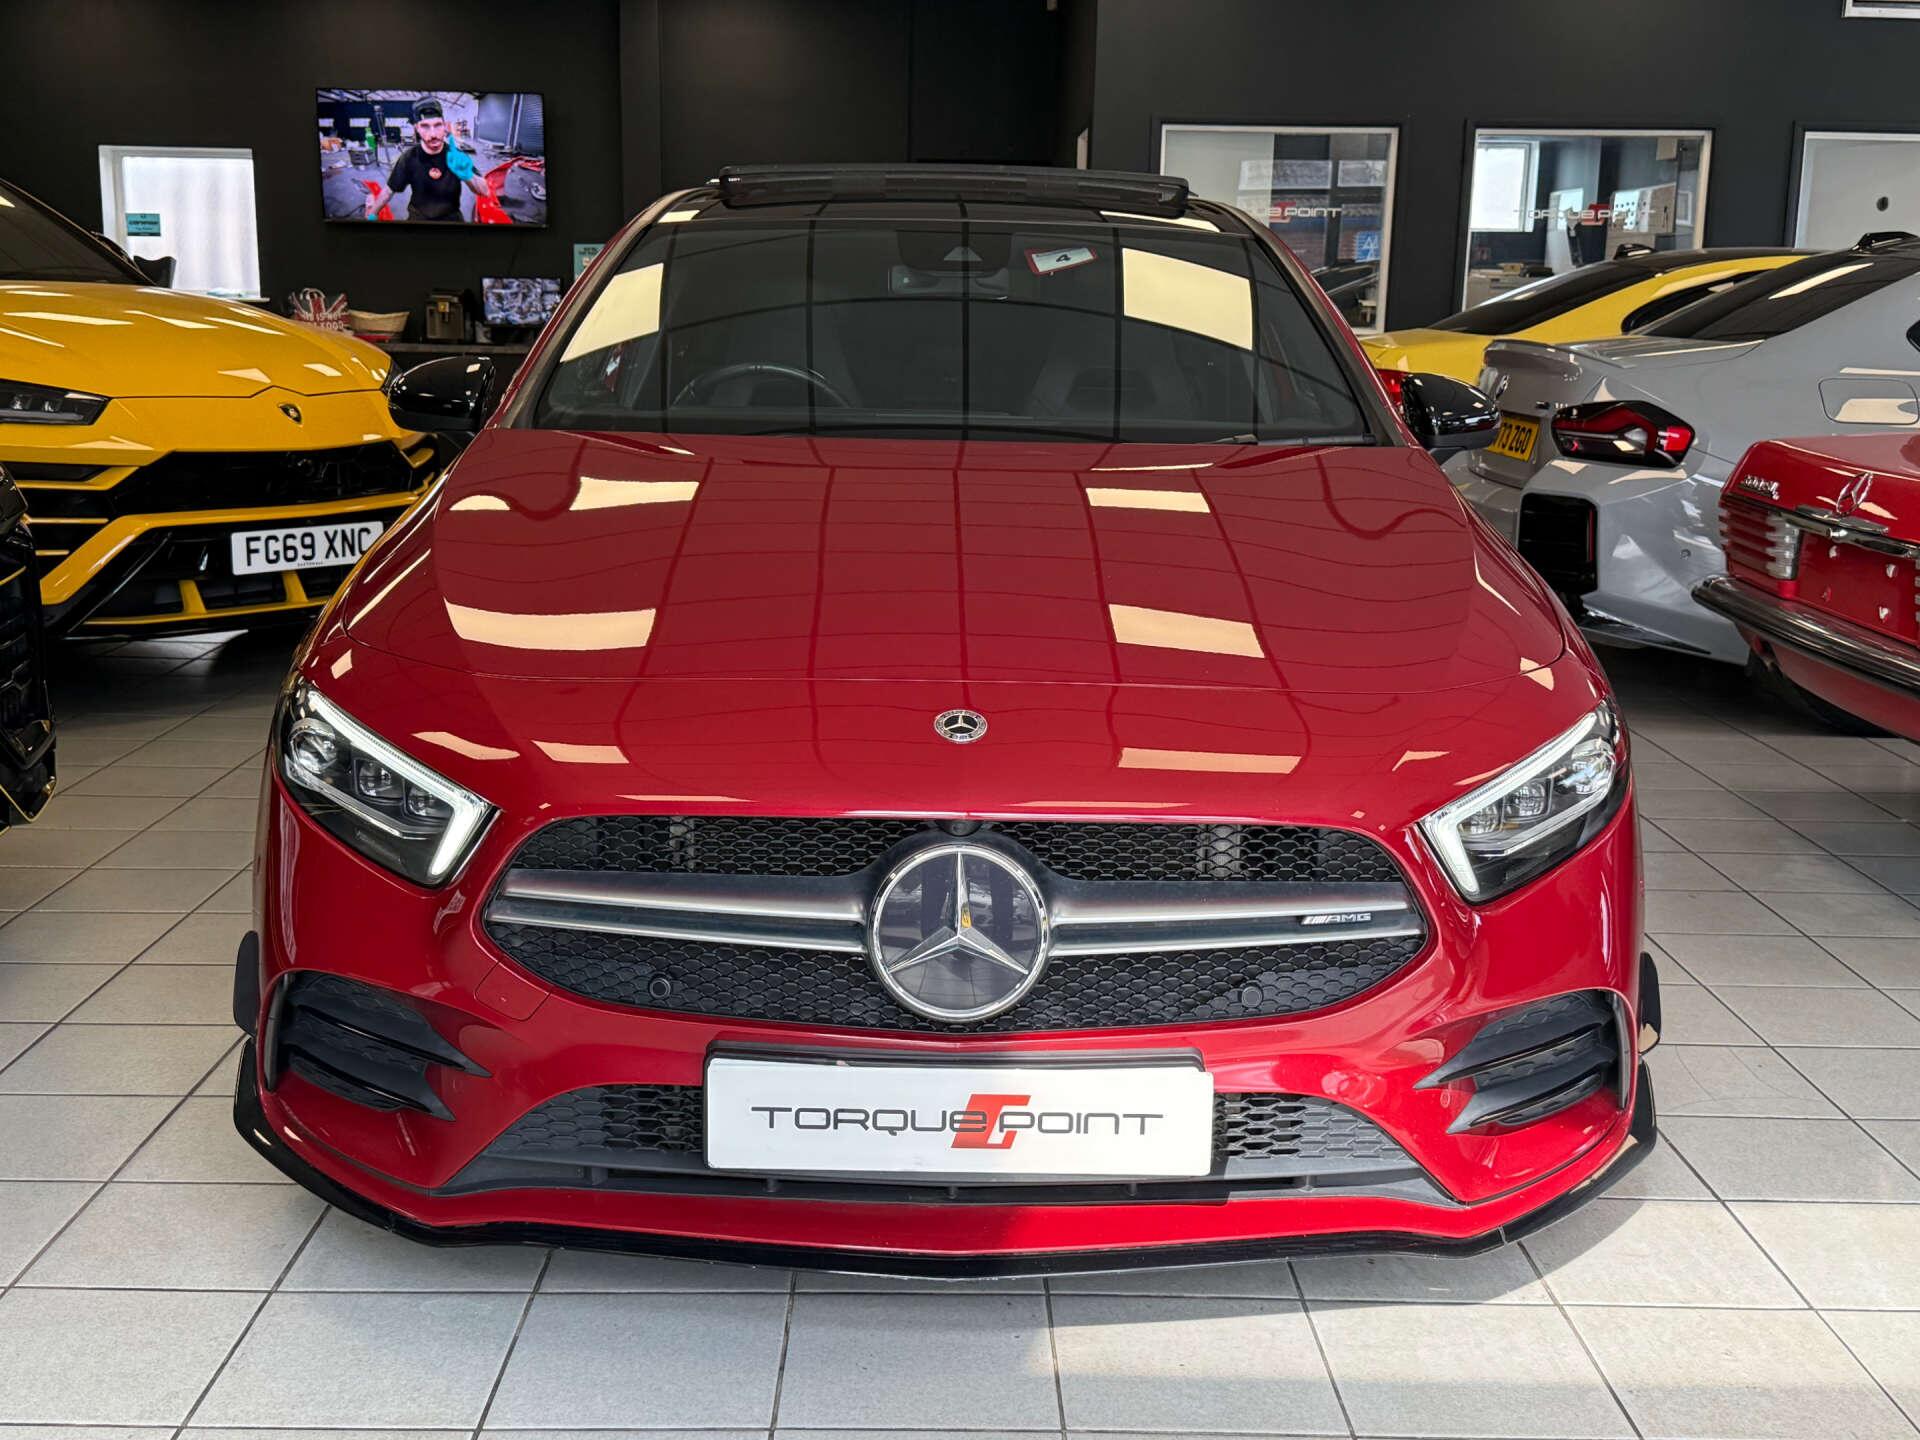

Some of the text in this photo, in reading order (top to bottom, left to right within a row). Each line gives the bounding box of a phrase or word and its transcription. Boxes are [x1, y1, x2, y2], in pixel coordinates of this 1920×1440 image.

[1284, 207, 1342, 218] POINT
[1598, 208, 1656, 220] POT
[1508, 424, 1532, 454] ZGO
[245, 527, 371, 567] FG69 XNC
[1326, 912, 1371, 925] AMG
[751, 1106, 1163, 1136] TORQUE POINT
